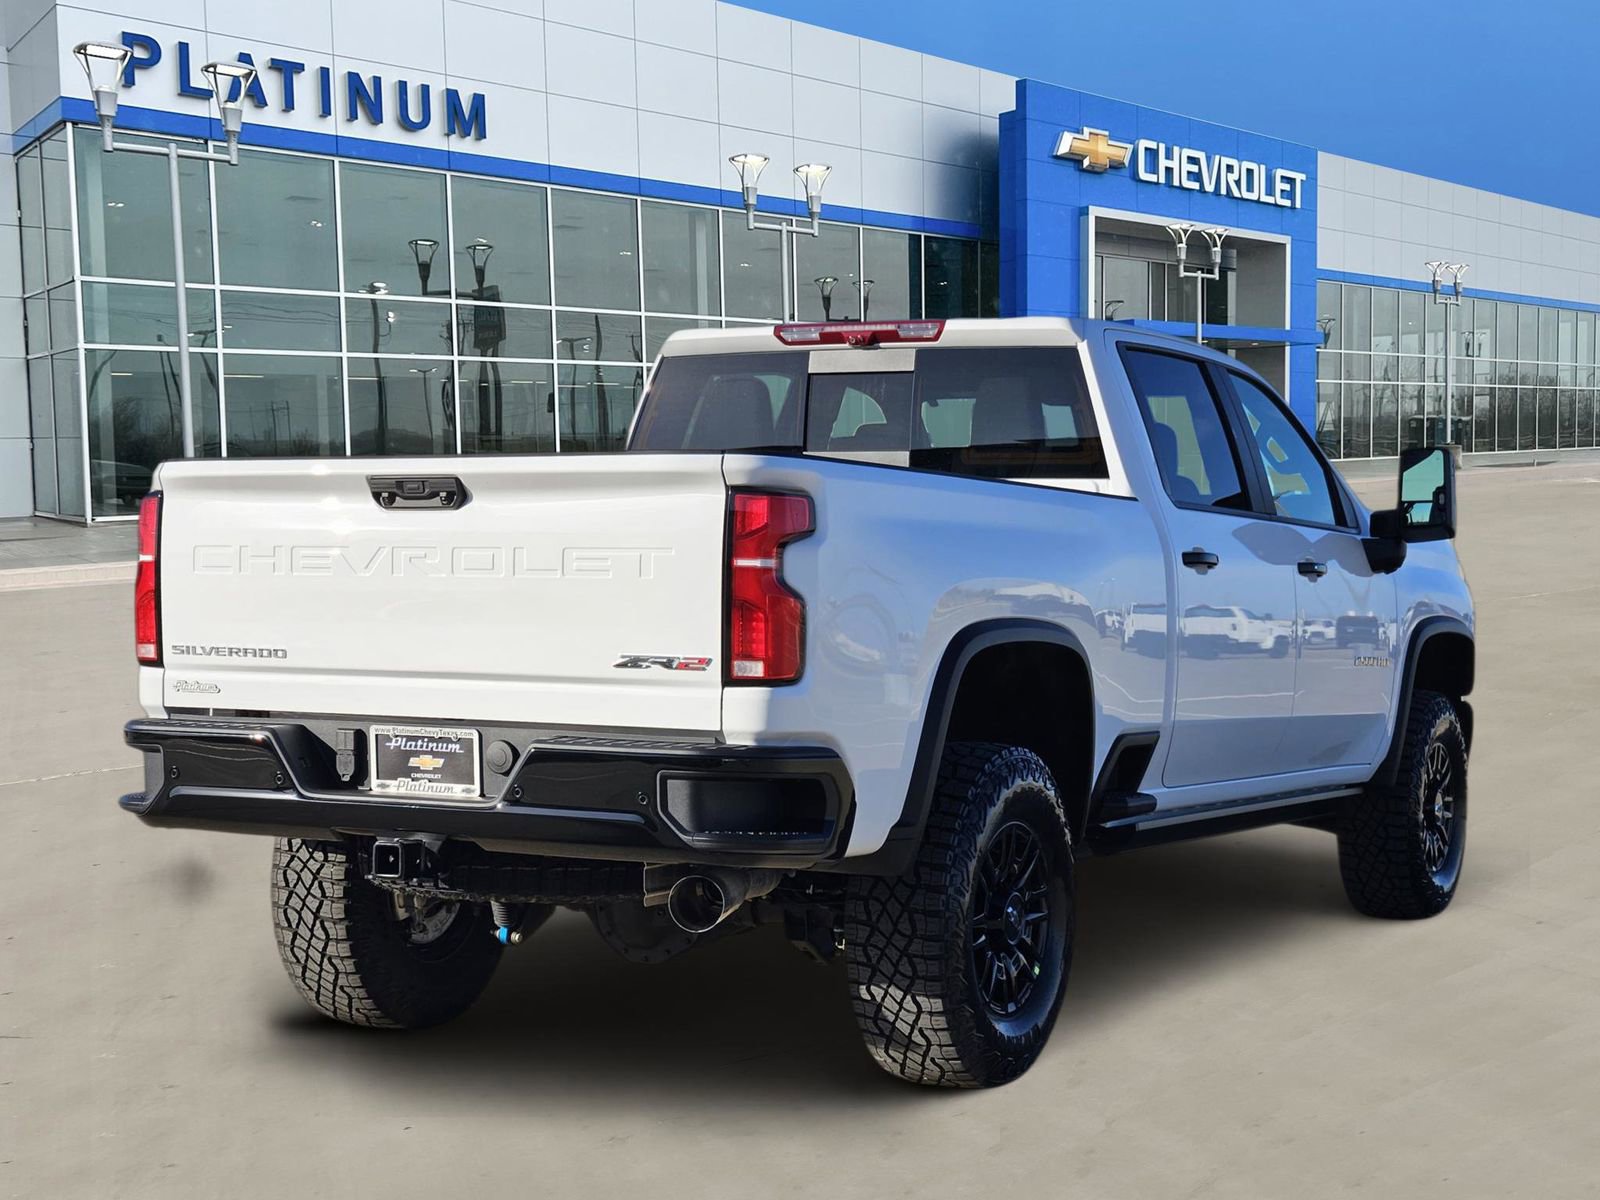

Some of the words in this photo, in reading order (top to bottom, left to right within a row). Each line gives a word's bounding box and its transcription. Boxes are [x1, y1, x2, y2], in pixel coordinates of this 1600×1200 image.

[121, 31, 487, 140] PLATINUM
[1136, 139, 1306, 209] CHEVROLET
[192, 544, 675, 580] CHEVROLET
[171, 645, 287, 659] SILVERADO
[612, 655, 713, 671] ZR2
[385, 737, 464, 753] Platinum
[391, 779, 457, 794] Platinum
